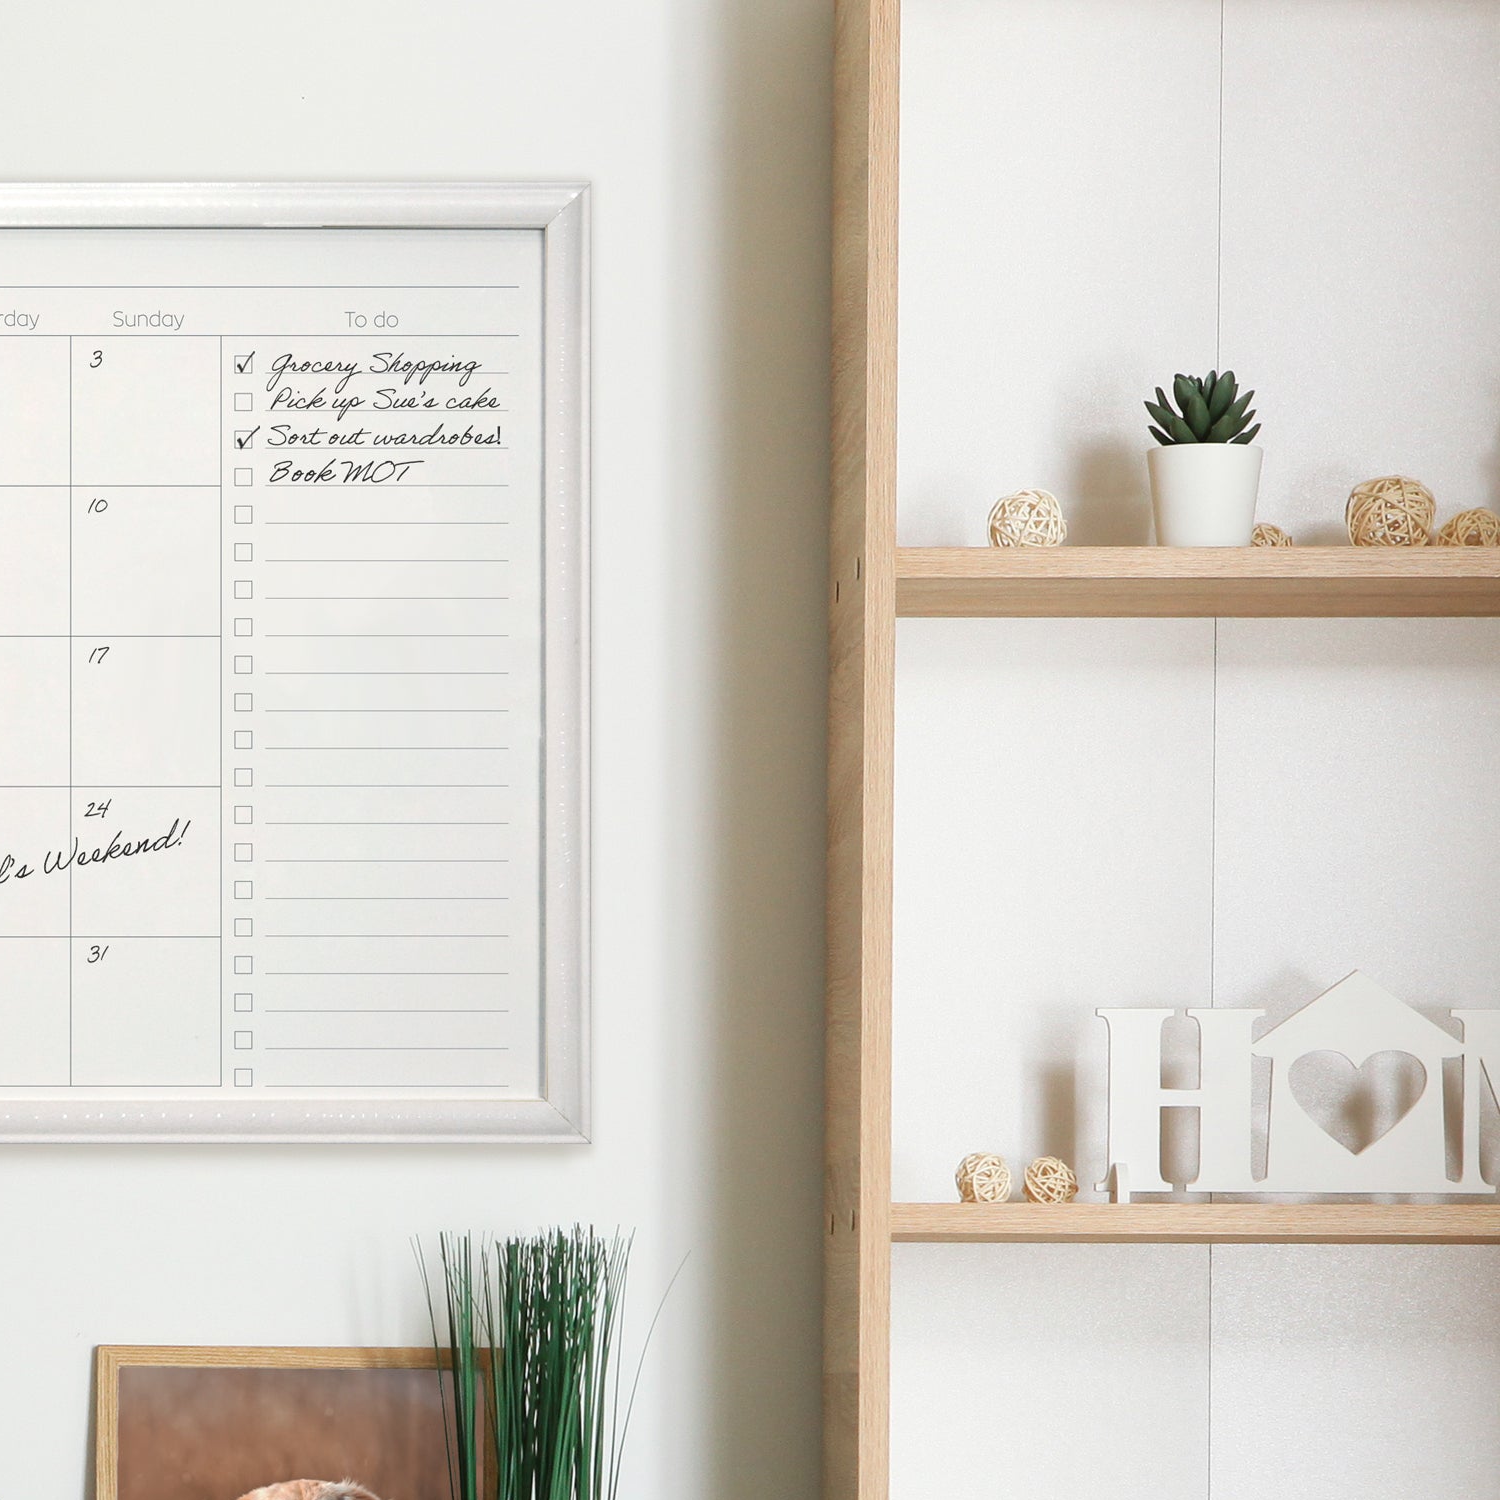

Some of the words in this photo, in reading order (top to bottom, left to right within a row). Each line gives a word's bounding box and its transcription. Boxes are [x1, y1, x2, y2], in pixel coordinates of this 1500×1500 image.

[112, 309, 185, 331] Sunday
[344, 310, 368, 329] To
[372, 310, 399, 329] do
[89, 349, 104, 369] 3
[266, 353, 362, 394] Grocery
[369, 352, 483, 387] Shopping
[270, 386, 327, 411] Pick
[332, 397, 366, 422] up
[373, 388, 439, 410] Sue's
[445, 386, 501, 410] cake
[267, 424, 328, 446] Sort
[328, 427, 372, 446] out
[373, 423, 502, 446] wardrobes!
[269, 457, 337, 484] Book
[340, 458, 426, 484] MOT
[87, 497, 109, 515] 10
[88, 646, 111, 665] 17
[83, 798, 113, 819] 24
[43, 817, 192, 875] Weekend!
[86, 944, 110, 964] 31
